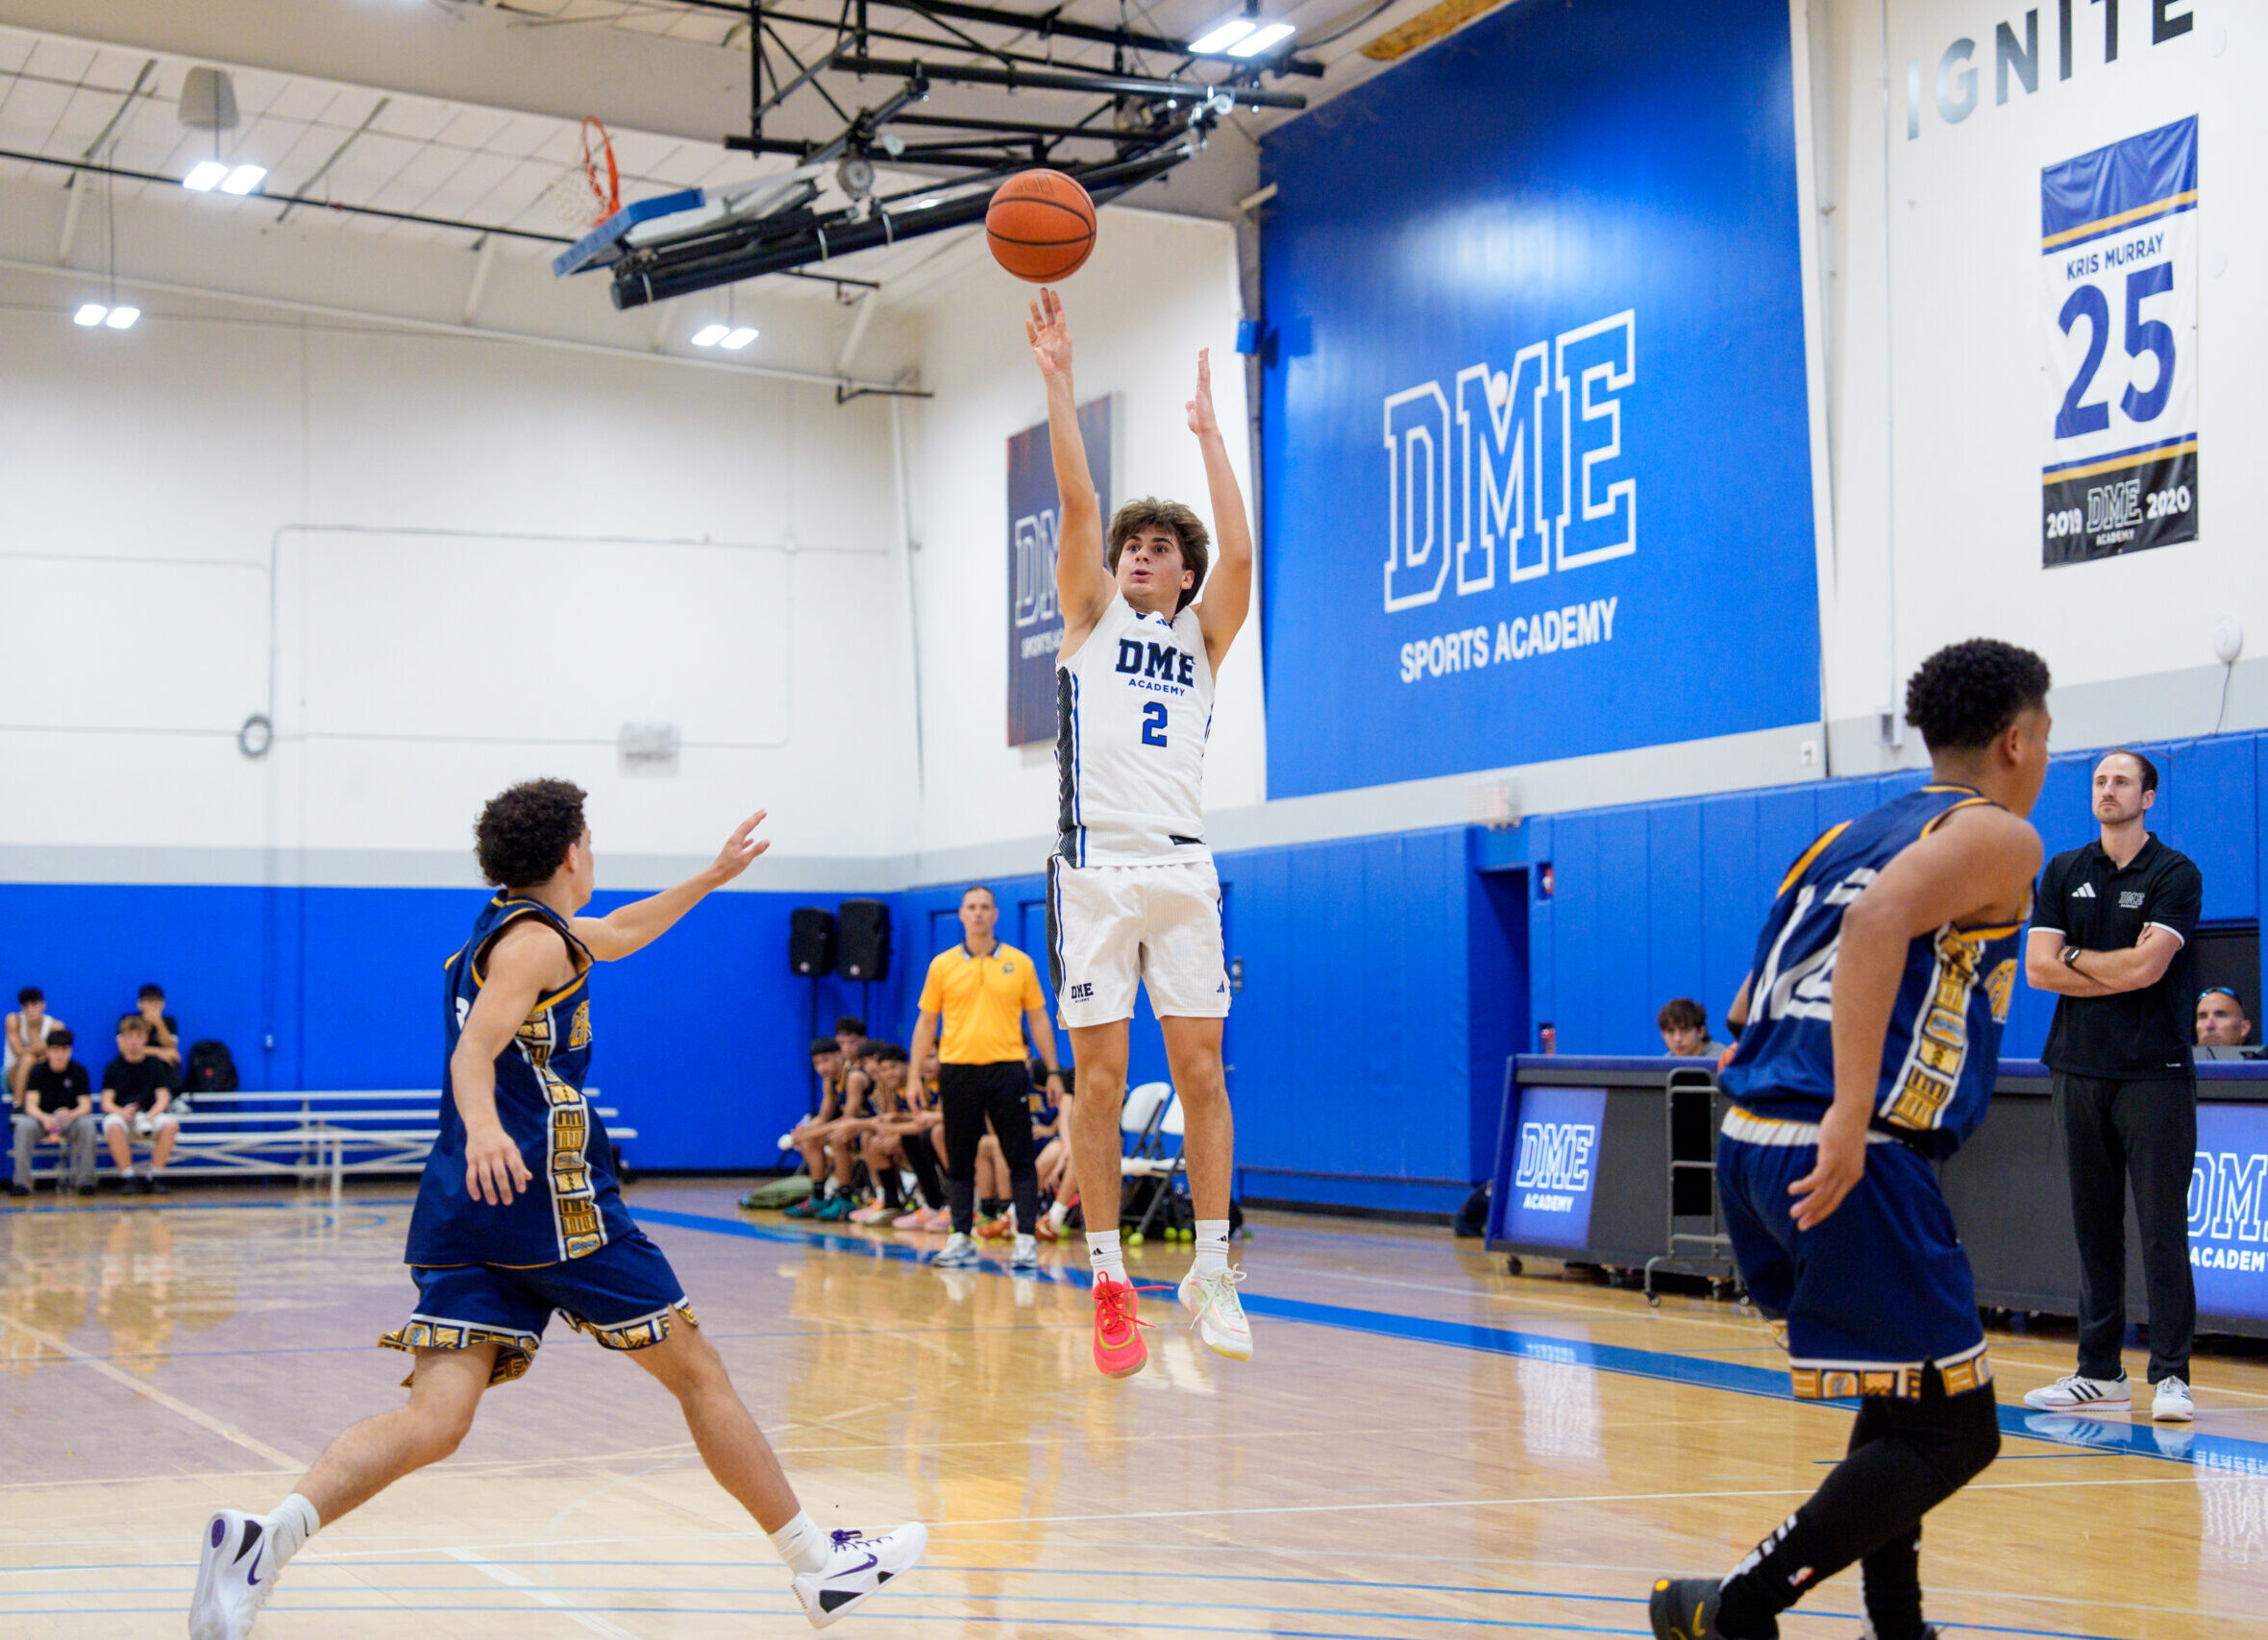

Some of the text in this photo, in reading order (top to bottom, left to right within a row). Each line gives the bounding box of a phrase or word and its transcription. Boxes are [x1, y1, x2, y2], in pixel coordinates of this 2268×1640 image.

[2066, 232, 2164, 281] KRIS MURRAY
[2055, 260, 2176, 440] 25
[1385, 308, 1637, 613] DME
[2046, 478, 2191, 539] 2019 DME 2020
[2096, 528, 2135, 547] ACADEMY
[1115, 638, 1196, 688] DME
[1399, 597, 1618, 683] SPORTS ACADEMY
[1128, 678, 1186, 697] ACADEMY
[1142, 701, 1168, 747] 2
[1072, 982, 1094, 999] DME
[1516, 1122, 1595, 1191] DME
[1522, 1192, 1574, 1212] ACADEMY
[2187, 1151, 2268, 1243] DM
[2190, 1246, 2268, 1272] ACADEM
